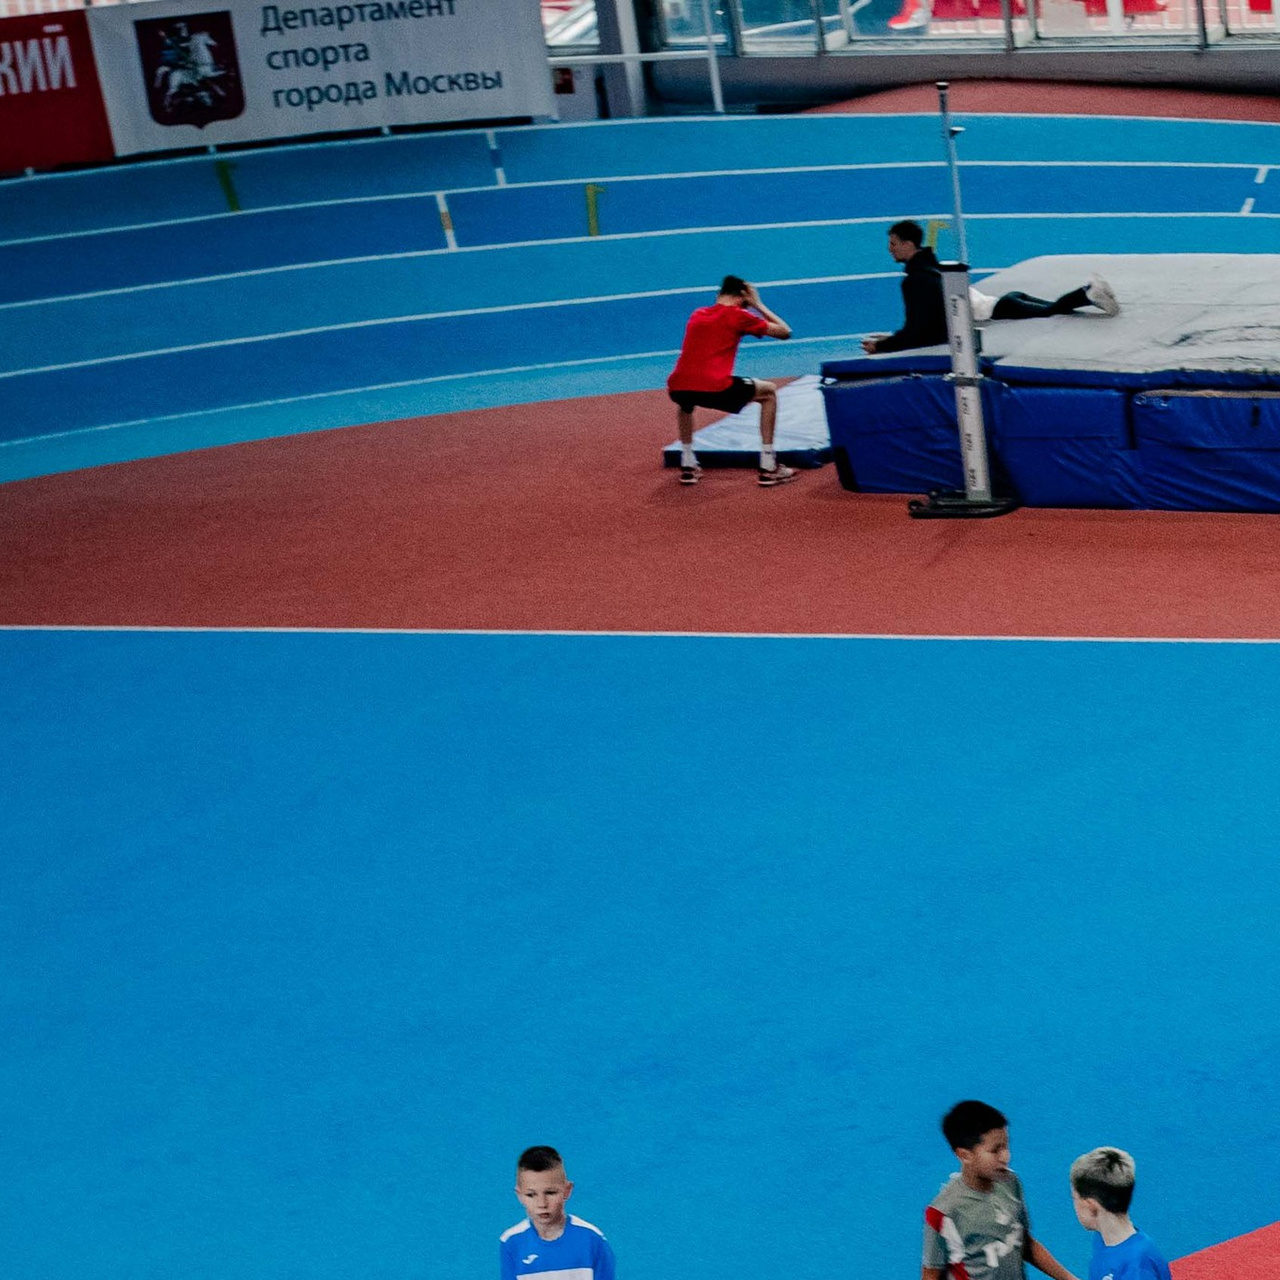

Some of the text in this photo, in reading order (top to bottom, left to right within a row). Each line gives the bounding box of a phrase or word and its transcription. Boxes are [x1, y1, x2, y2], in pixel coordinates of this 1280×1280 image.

[260, 0, 455, 37] Департамент
[266, 42, 370, 71] спорта
[272, 70, 503, 112] города Москвы
